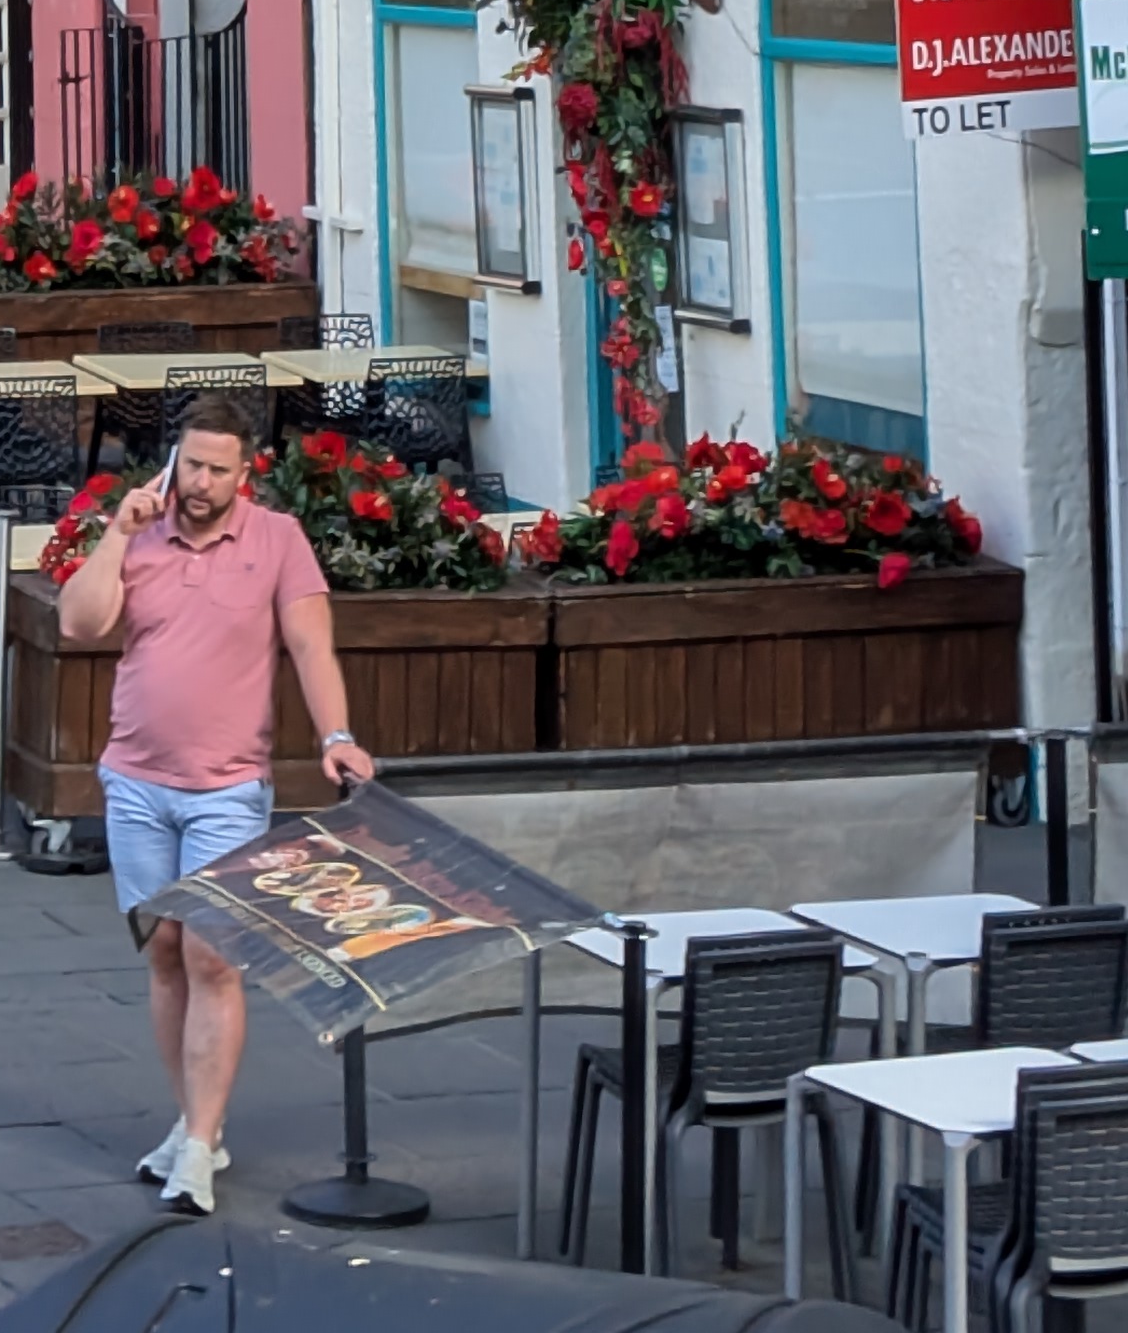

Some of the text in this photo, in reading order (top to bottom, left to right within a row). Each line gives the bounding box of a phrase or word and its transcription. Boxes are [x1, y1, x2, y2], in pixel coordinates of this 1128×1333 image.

[911, 28, 1075, 77] D.J.ALEXANDE
[912, 99, 1011, 136] TO LET
